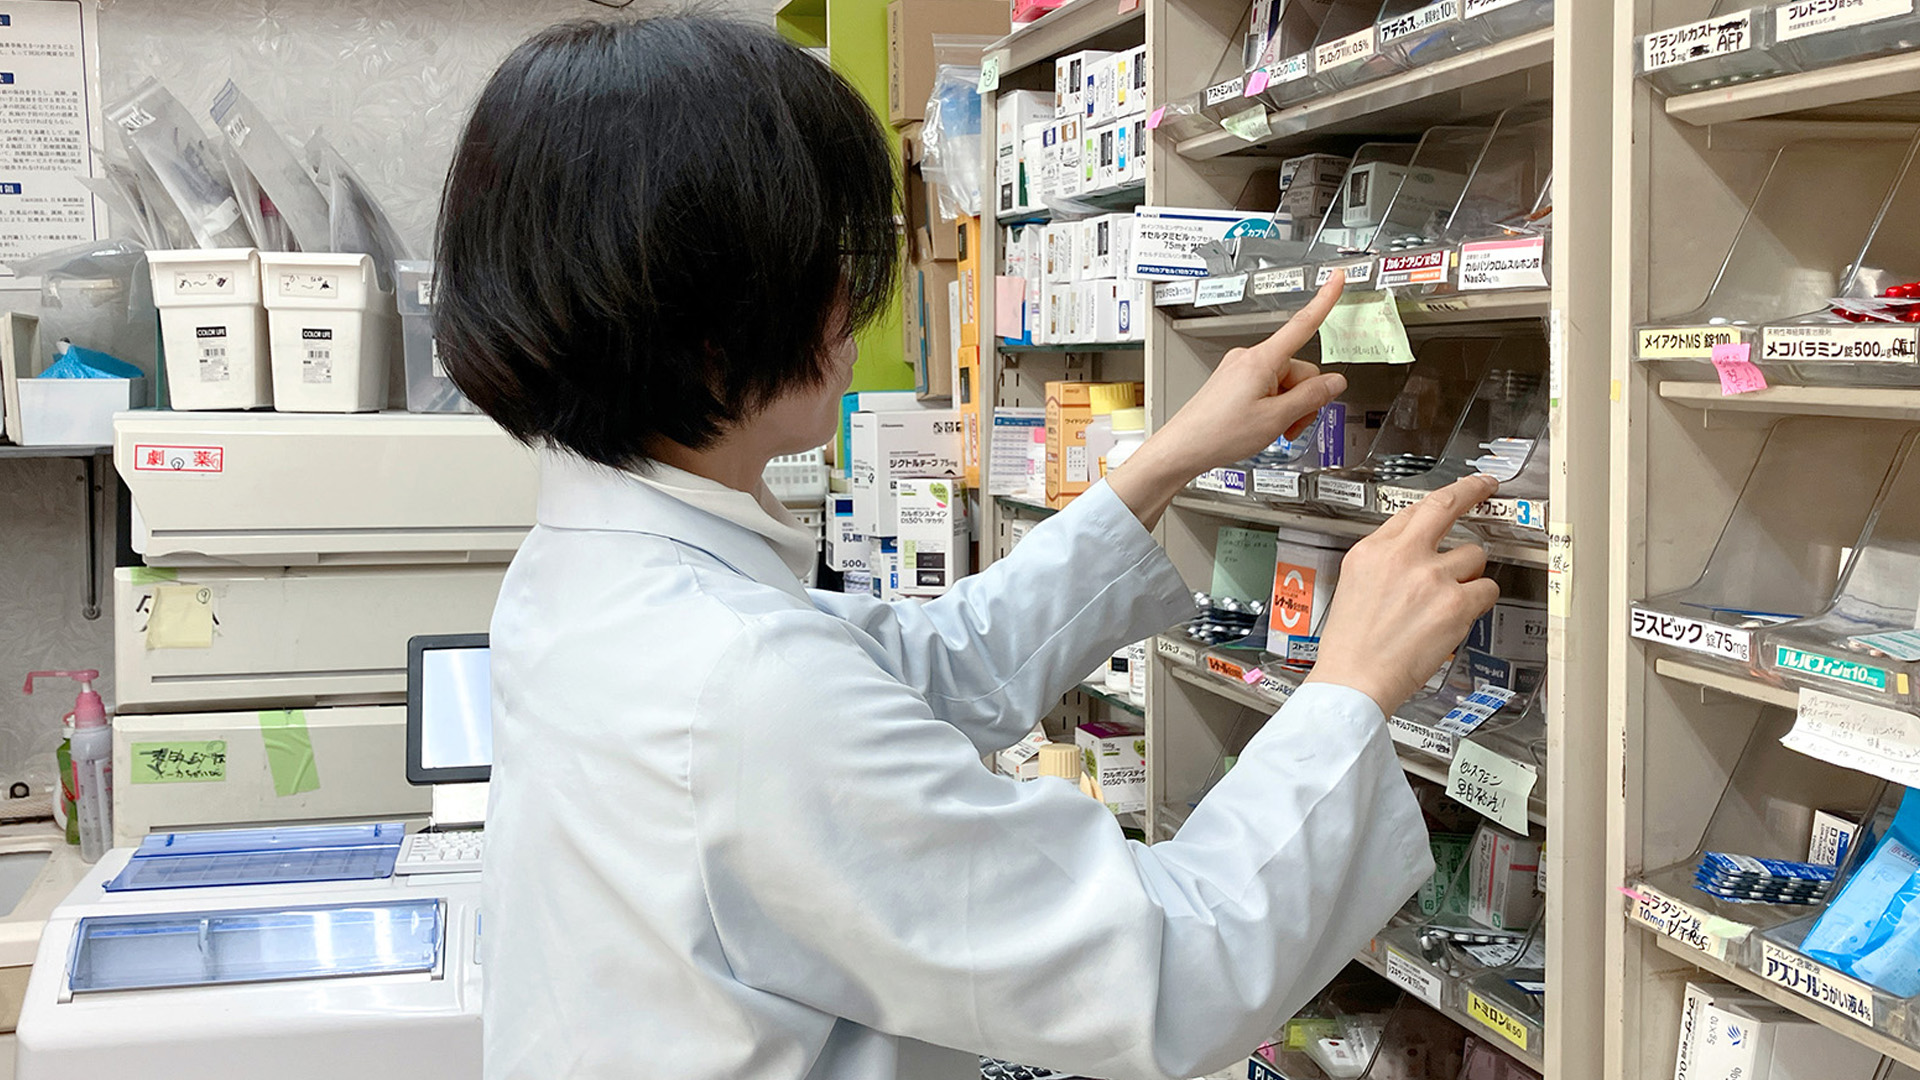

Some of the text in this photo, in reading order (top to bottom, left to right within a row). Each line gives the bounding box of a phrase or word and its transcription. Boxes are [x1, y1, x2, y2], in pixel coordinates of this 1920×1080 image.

[1163, 242, 1187, 252] 75mg
[303, 330, 321, 338] COLOR
[890, 459, 958, 469] ジクトルテープ 75mg
[842, 559, 866, 568] 500g
[1632, 611, 1704, 644] ラスビック
[1639, 906, 1665, 931] 10mg
